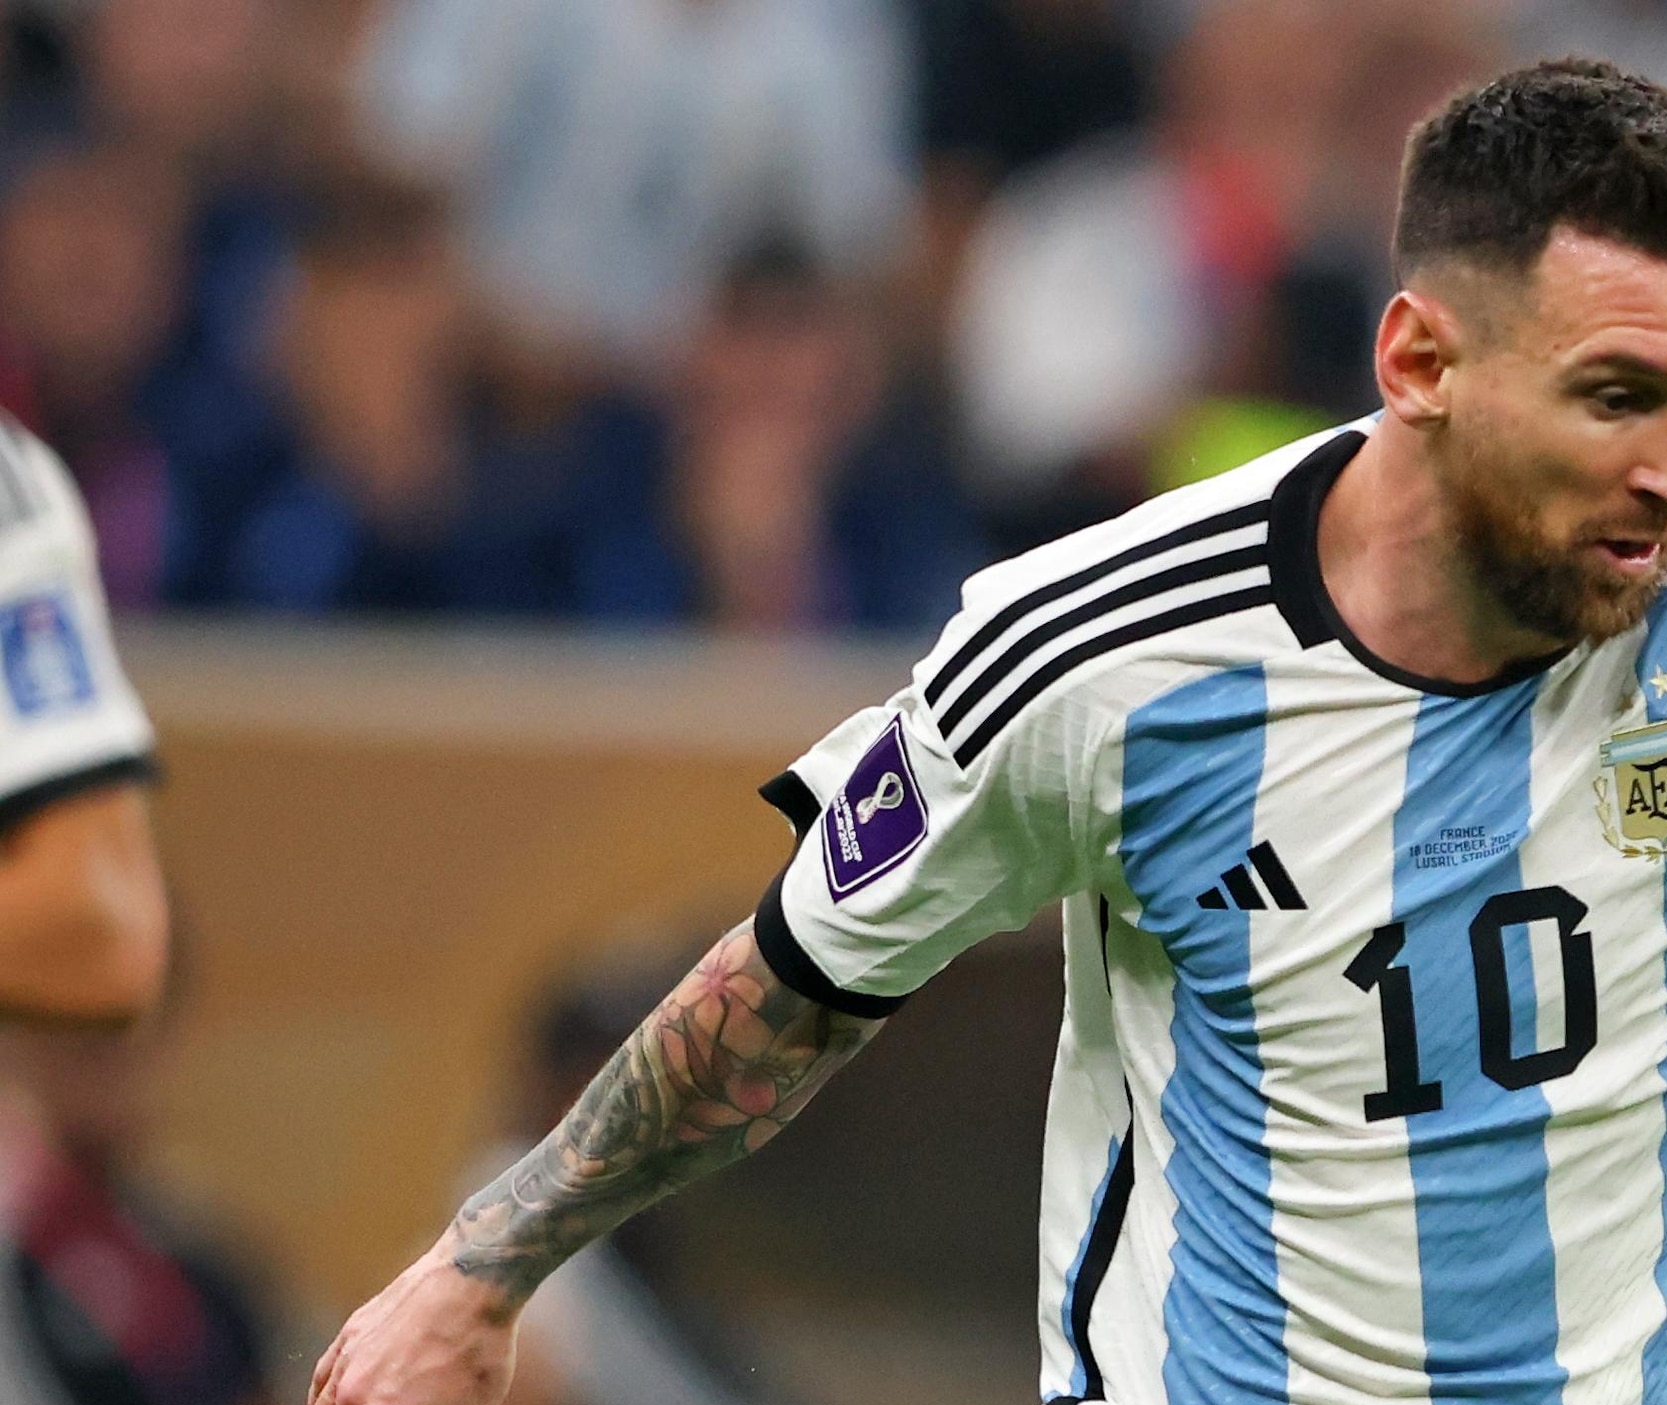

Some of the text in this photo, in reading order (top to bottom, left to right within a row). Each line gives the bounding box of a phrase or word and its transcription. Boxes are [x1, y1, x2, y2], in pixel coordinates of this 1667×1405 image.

[1440, 826, 1486, 840] FRANCE
[850, 840, 863, 862] CUP
[1424, 839, 1486, 855] DECEMBER
[1415, 855, 1459, 869] LUSAIL
[1342, 885, 1598, 1123] 10
